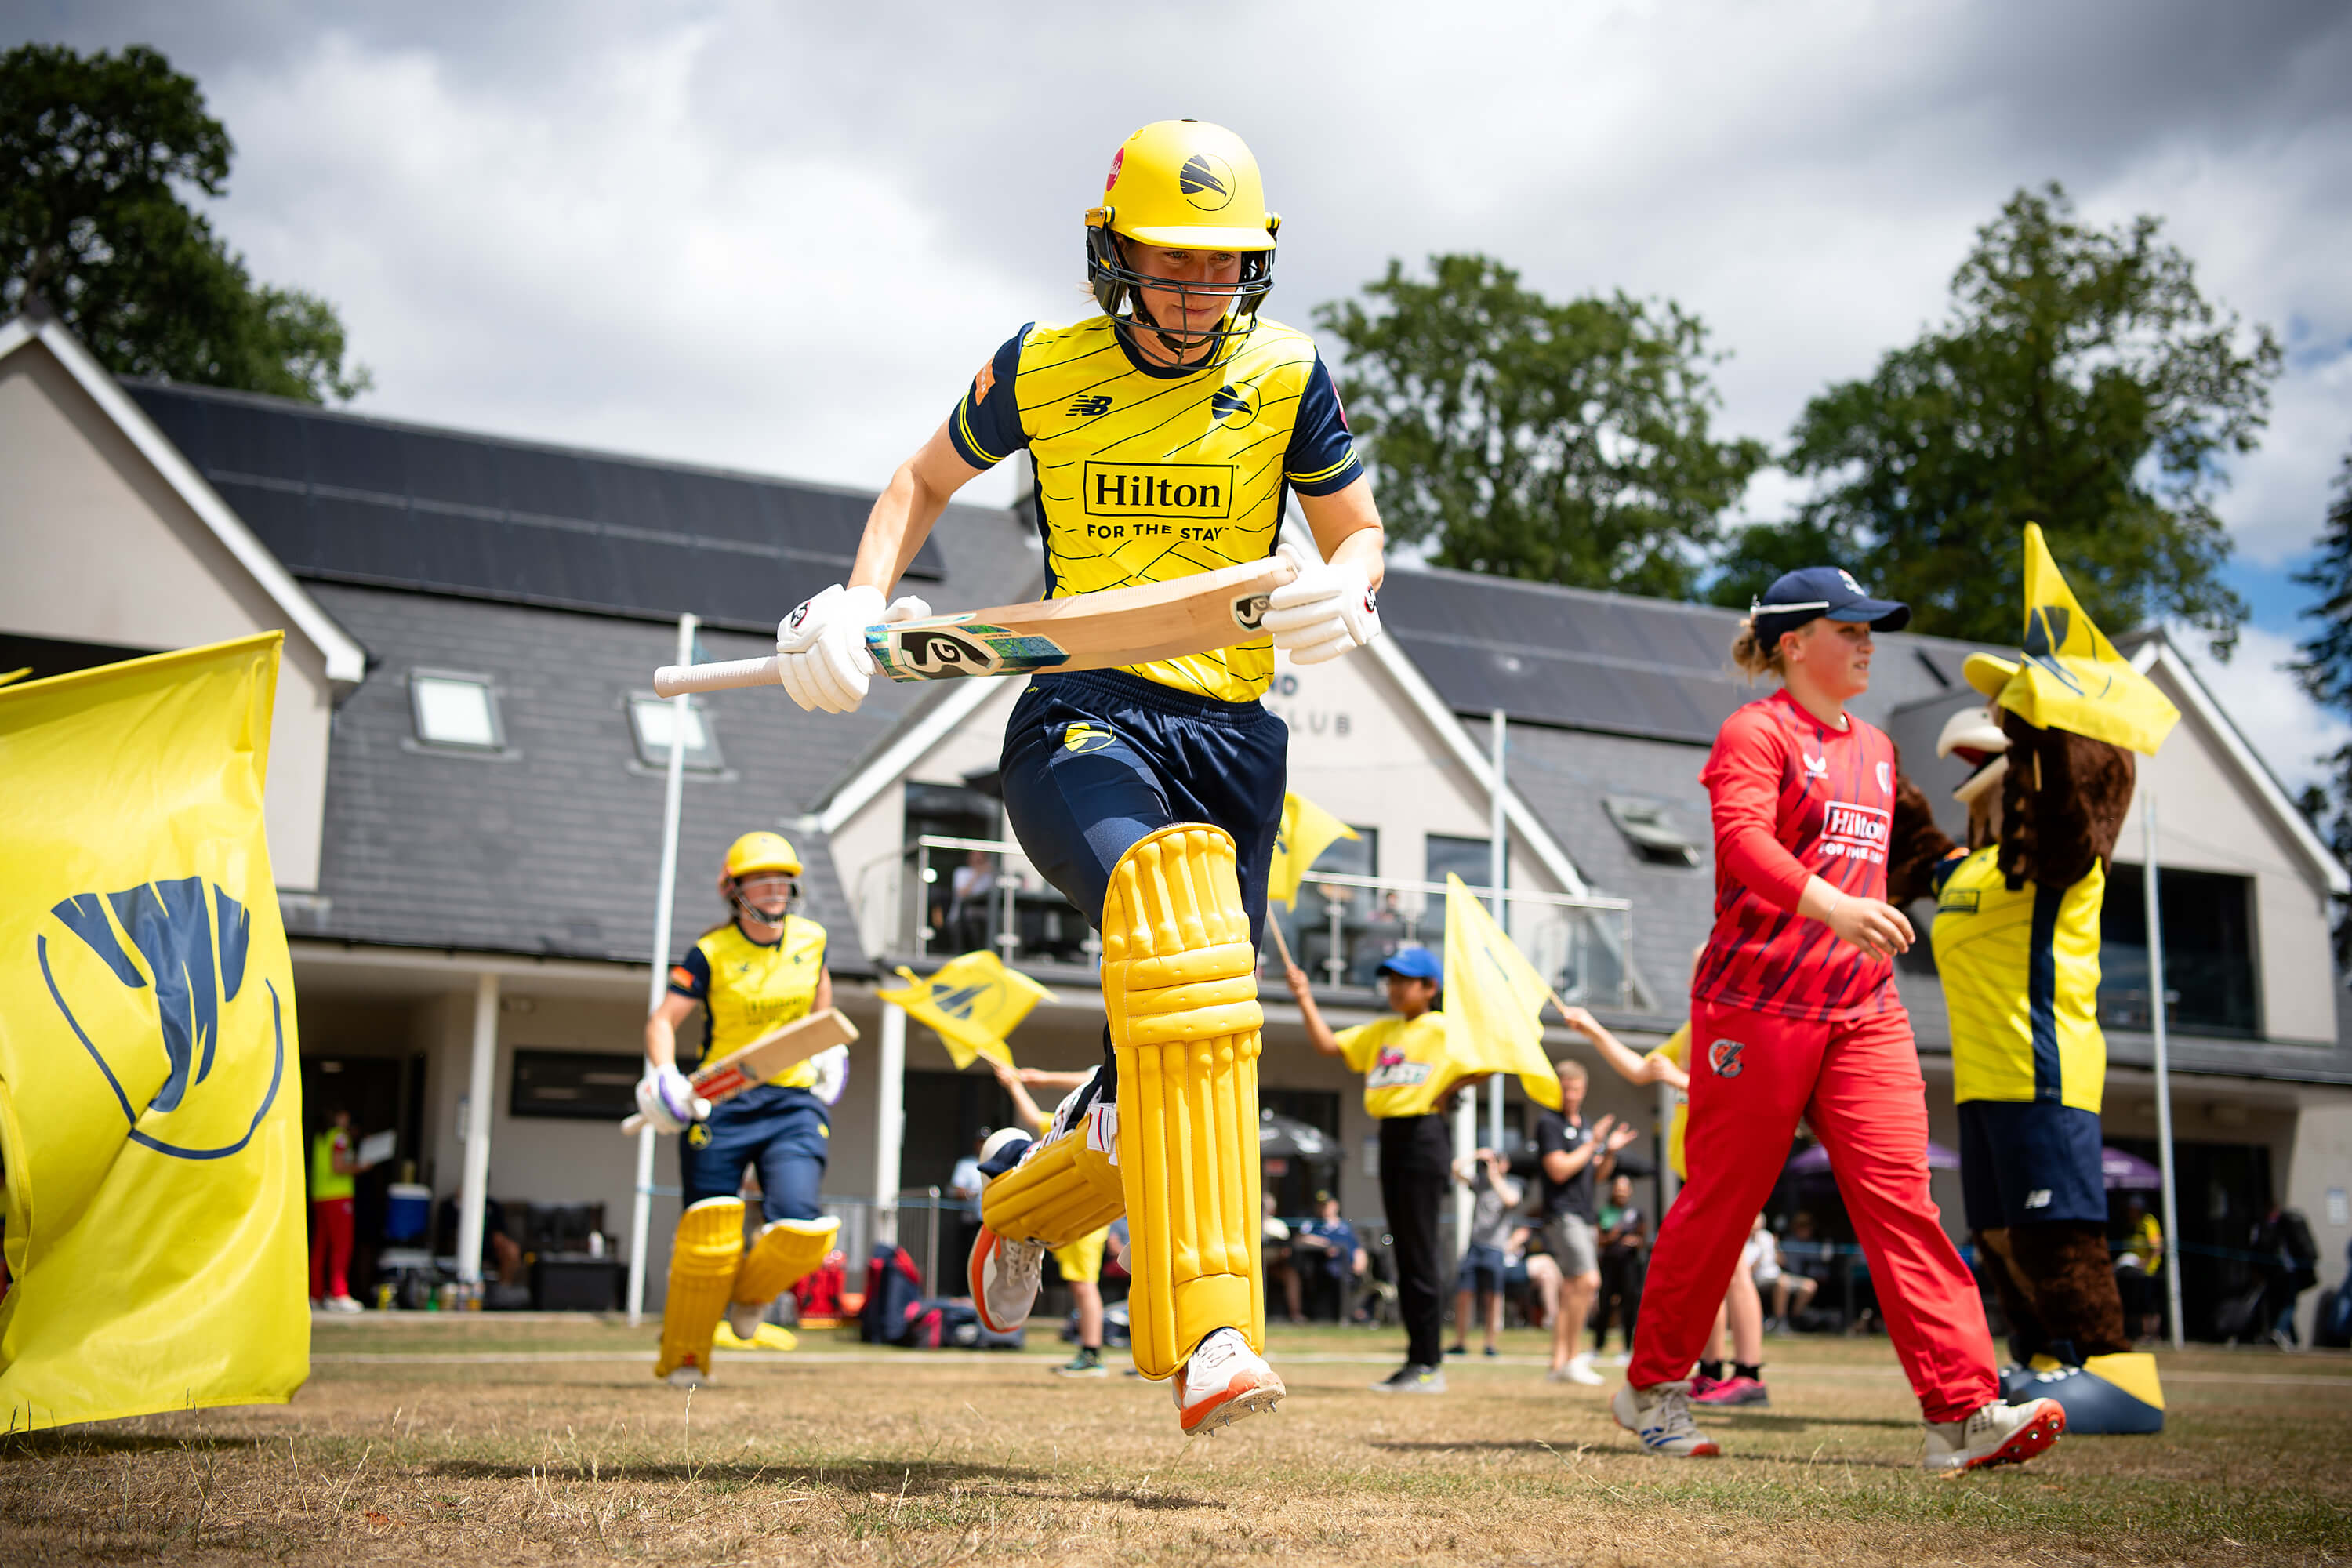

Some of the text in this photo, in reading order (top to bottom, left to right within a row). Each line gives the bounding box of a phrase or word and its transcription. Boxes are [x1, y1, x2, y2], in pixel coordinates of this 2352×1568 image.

[1095, 474, 1221, 508] Hilton
[1087, 524, 1124, 539] FOR
[1133, 524, 1172, 536] THE
[1269, 706, 1352, 735] LUB
